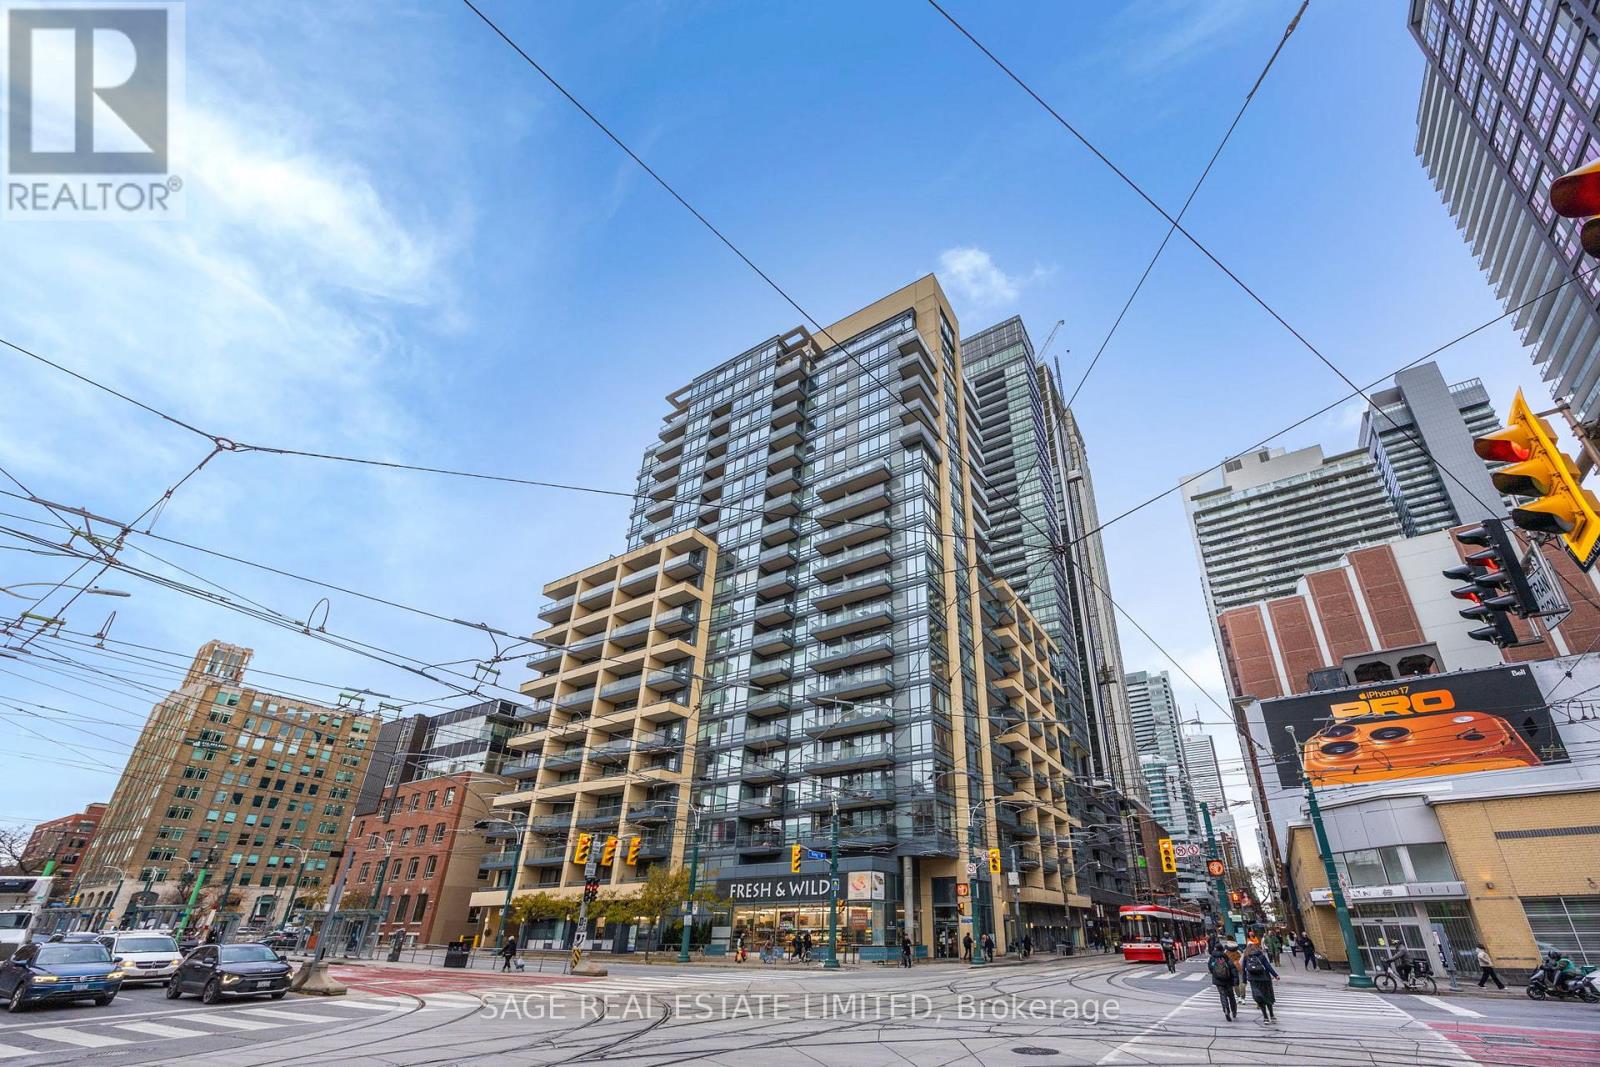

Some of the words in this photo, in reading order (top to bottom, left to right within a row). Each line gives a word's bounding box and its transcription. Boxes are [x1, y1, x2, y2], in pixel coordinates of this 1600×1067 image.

[1511, 668, 1527, 677] Bell
[1367, 688, 1400, 699] iPhone
[1400, 686, 1409, 694] 17
[1330, 689, 1456, 723] PRO
[730, 882, 771, 898] FRESH
[775, 882, 786, 897] &
[789, 879, 830, 896] WILD
